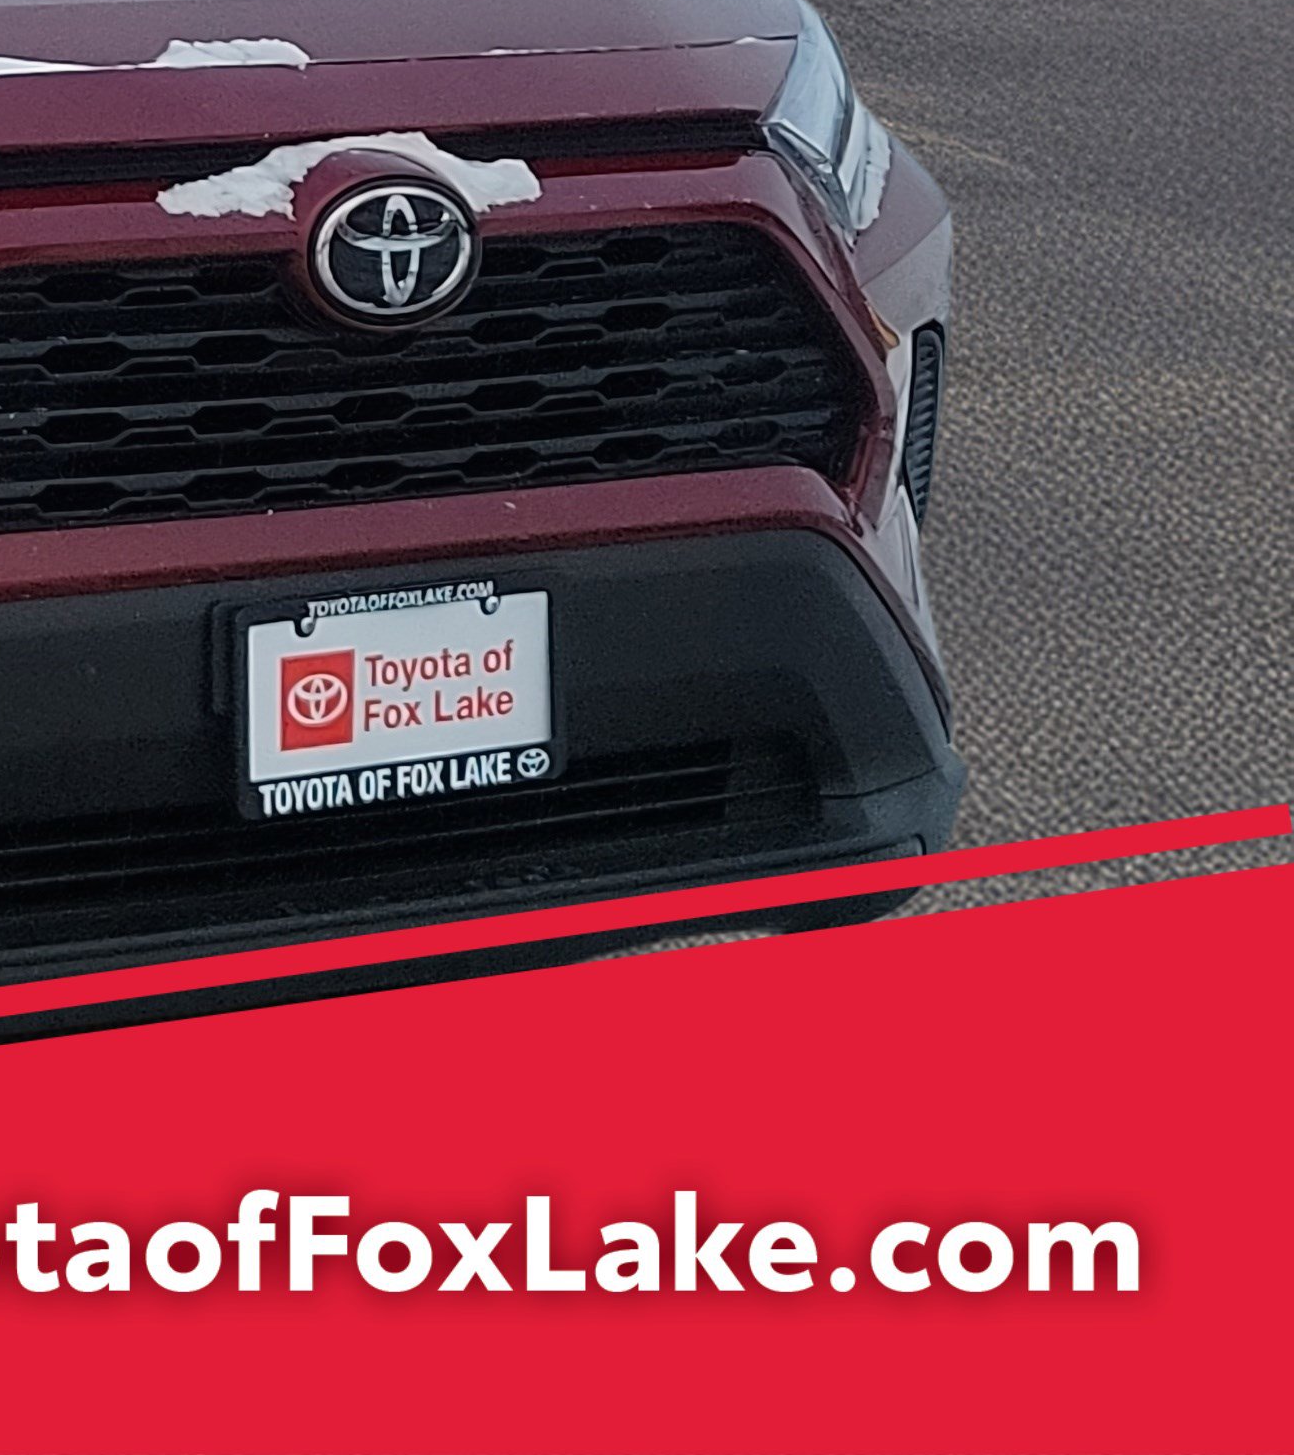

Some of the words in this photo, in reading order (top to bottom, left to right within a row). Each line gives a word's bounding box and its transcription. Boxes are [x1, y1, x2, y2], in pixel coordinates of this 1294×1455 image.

[364, 647, 471, 692] Toyota
[482, 639, 515, 673] of
[363, 697, 423, 732] Fox
[434, 685, 514, 723] Lake
[259, 773, 354, 817] TOYOTA
[358, 766, 393, 802] OF
[396, 758, 445, 798] FOX
[449, 751, 512, 791] LAKE
